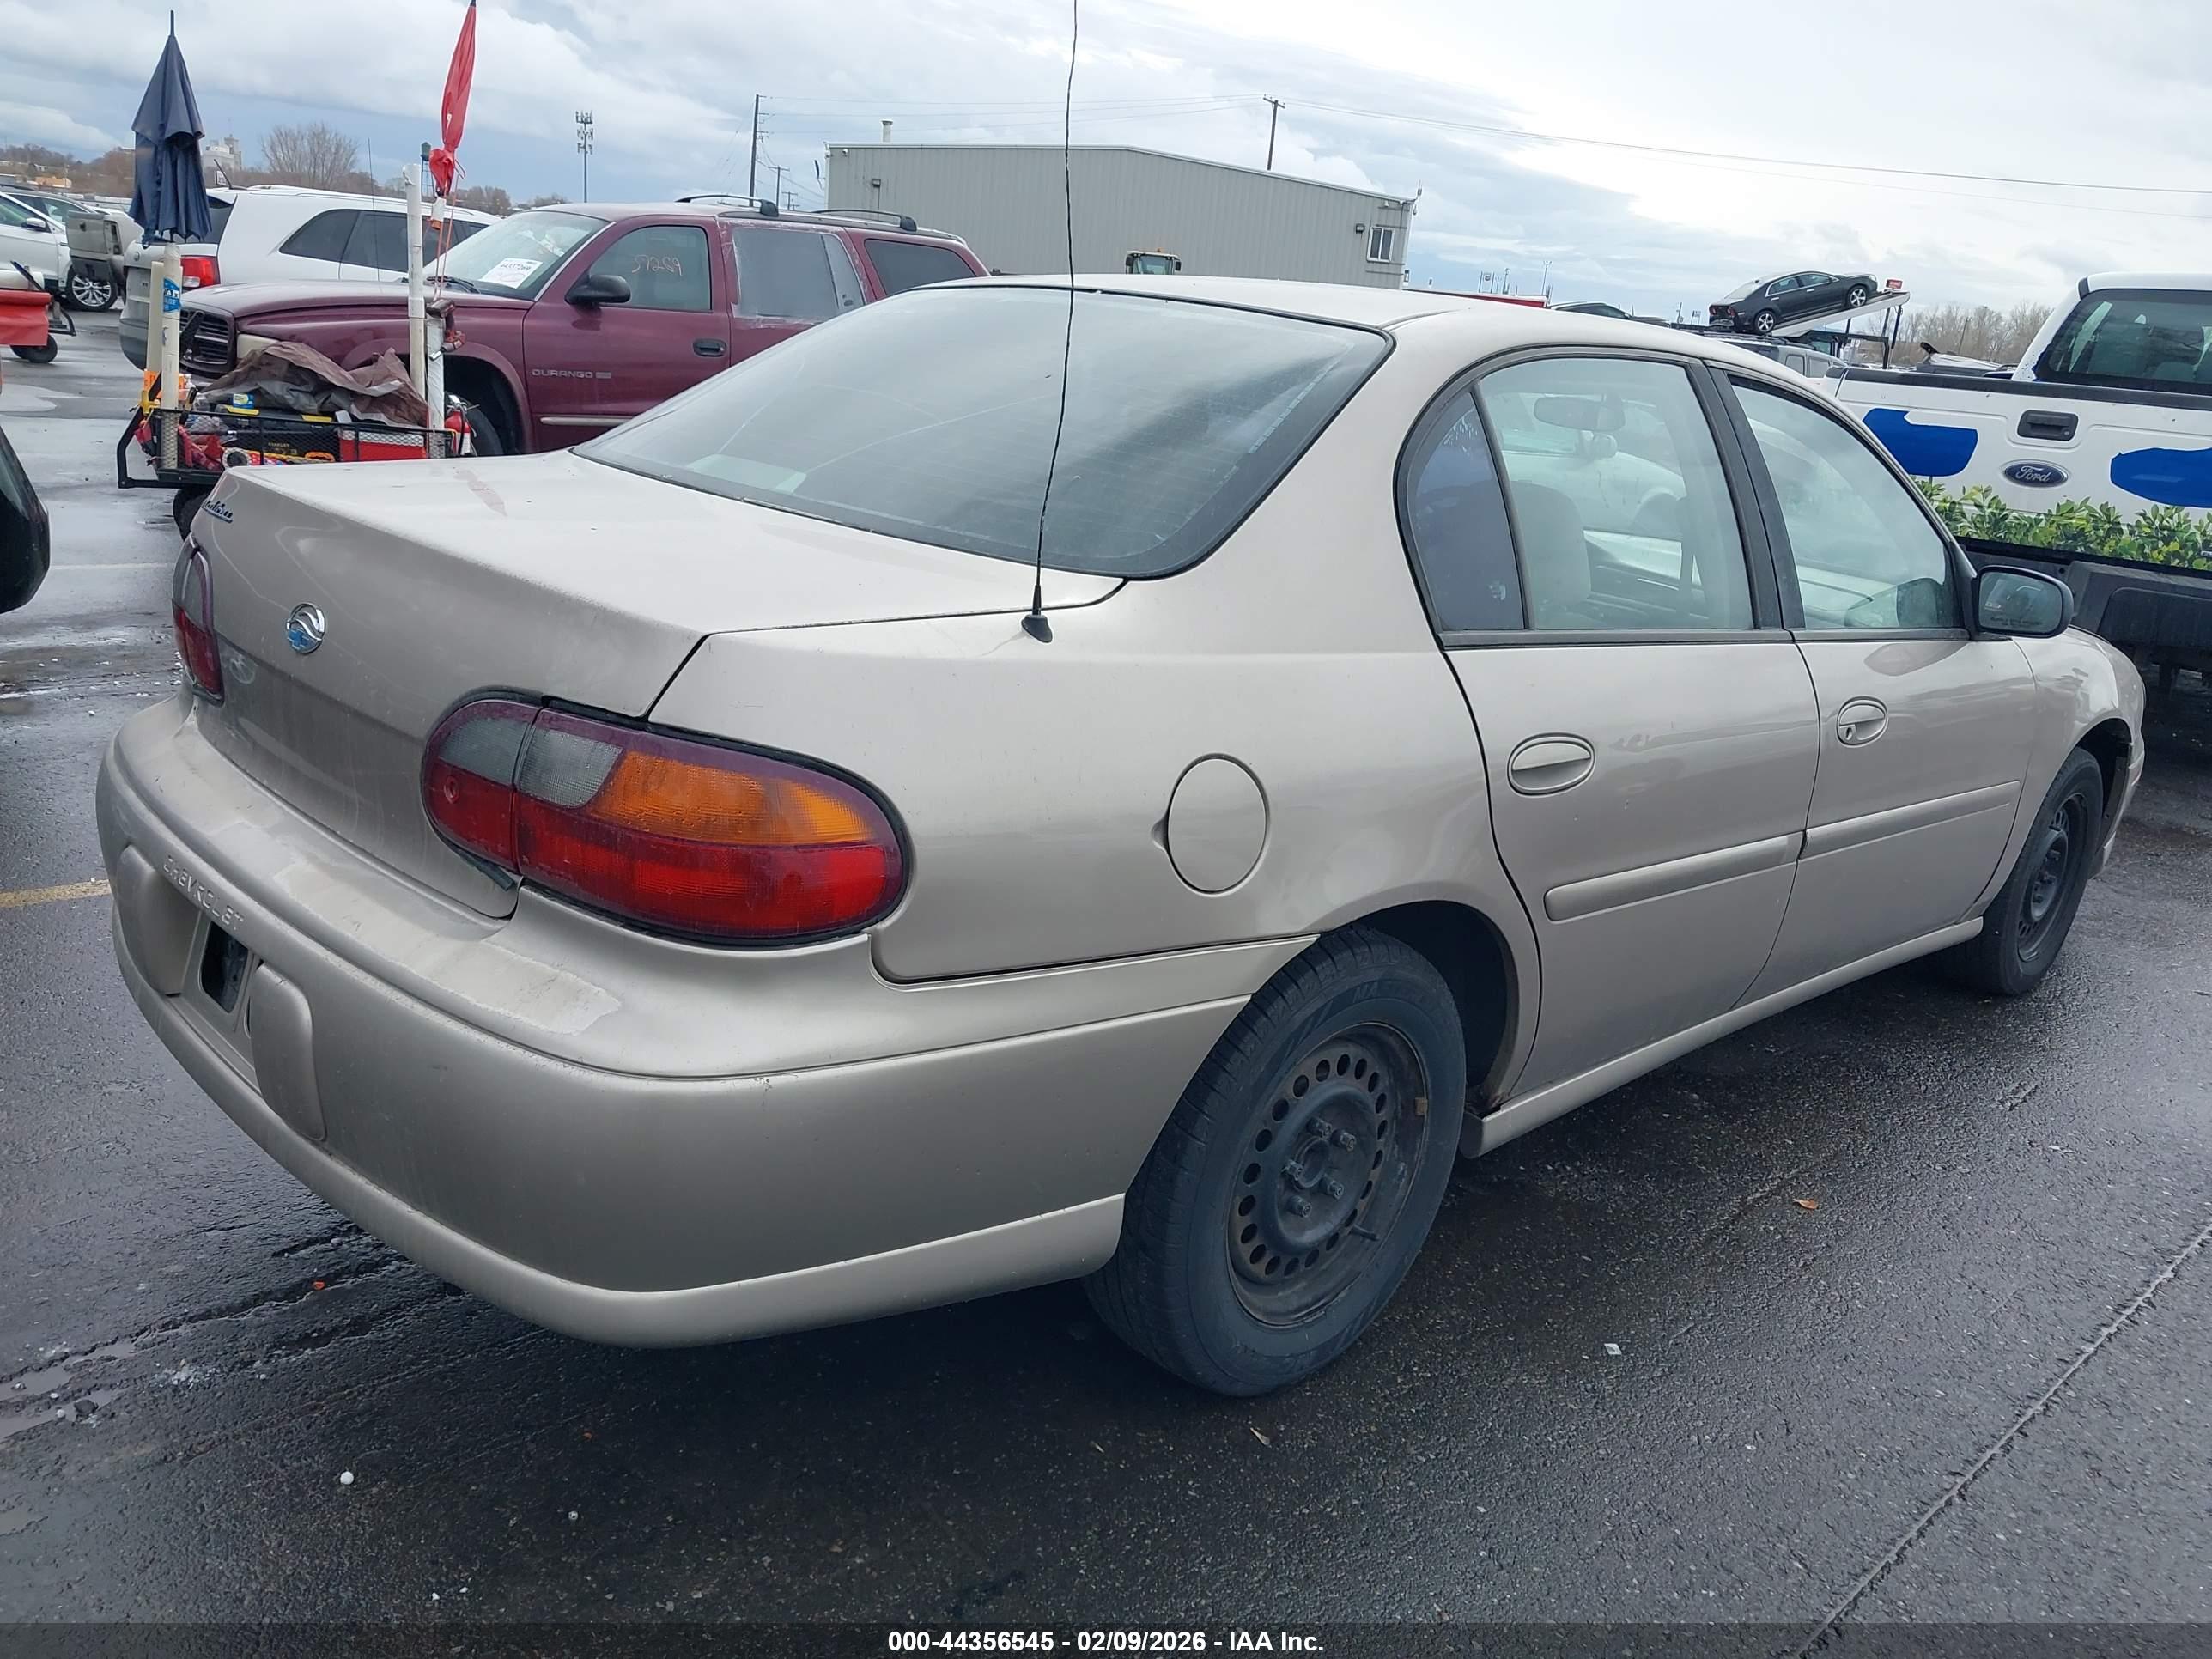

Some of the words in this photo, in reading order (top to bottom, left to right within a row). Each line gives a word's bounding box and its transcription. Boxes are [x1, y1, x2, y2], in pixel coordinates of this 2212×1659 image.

[532, 368, 593, 379] DURANGO
[2015, 465, 2052, 483] Ford
[163, 855, 245, 931] CHEVROLET
